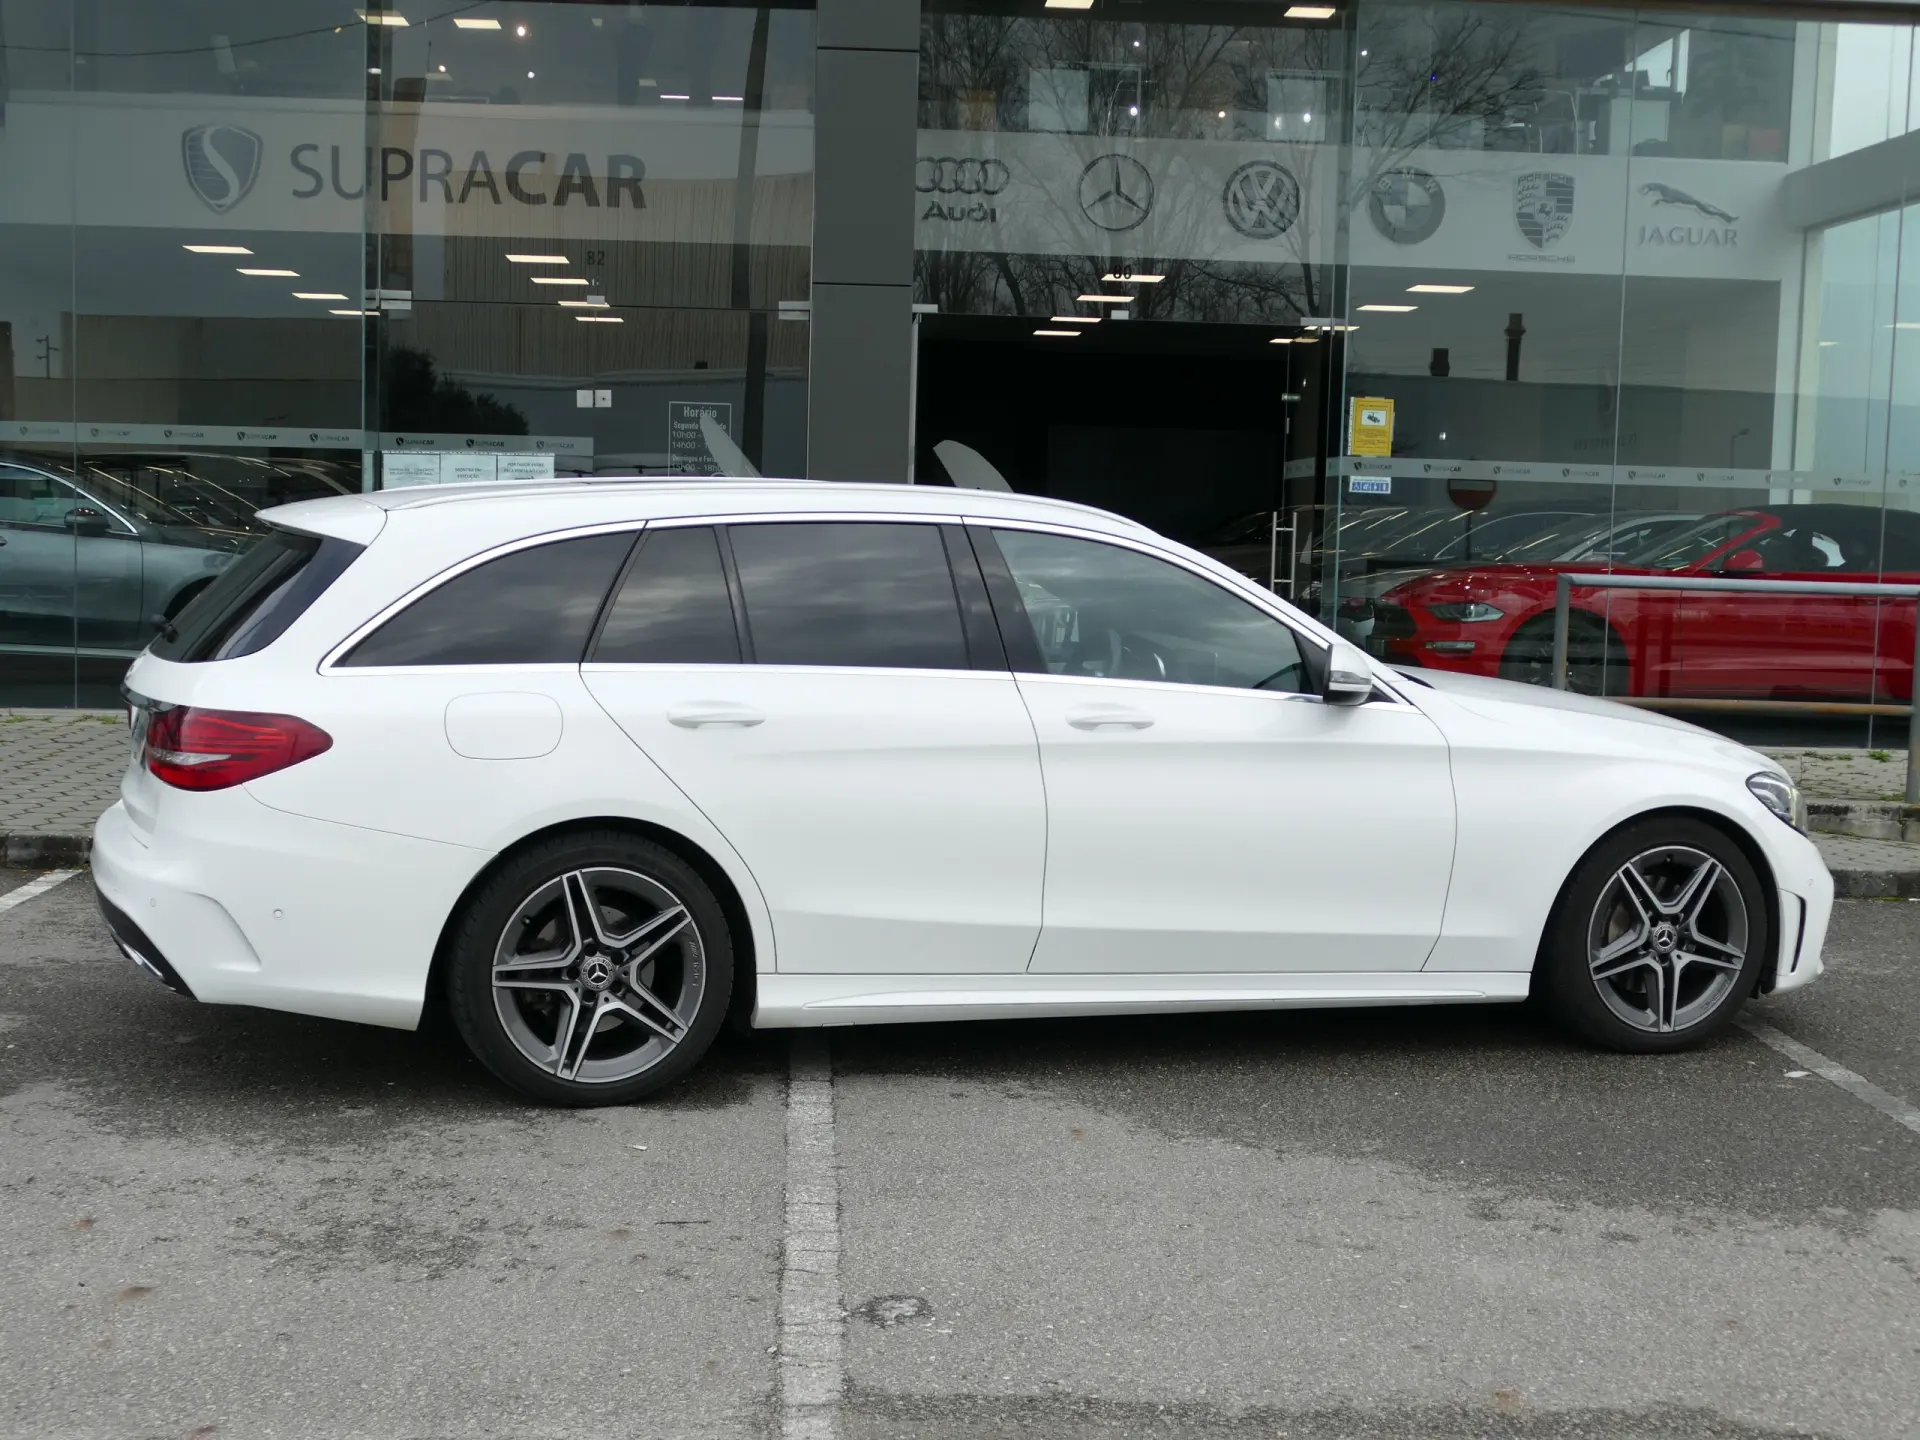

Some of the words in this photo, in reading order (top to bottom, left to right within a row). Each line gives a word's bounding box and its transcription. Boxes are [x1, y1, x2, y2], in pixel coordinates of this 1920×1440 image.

[289, 143, 648, 209] SUPRACAR
[1637, 226, 1739, 248] JAGUAR
[587, 250, 605, 266] 82
